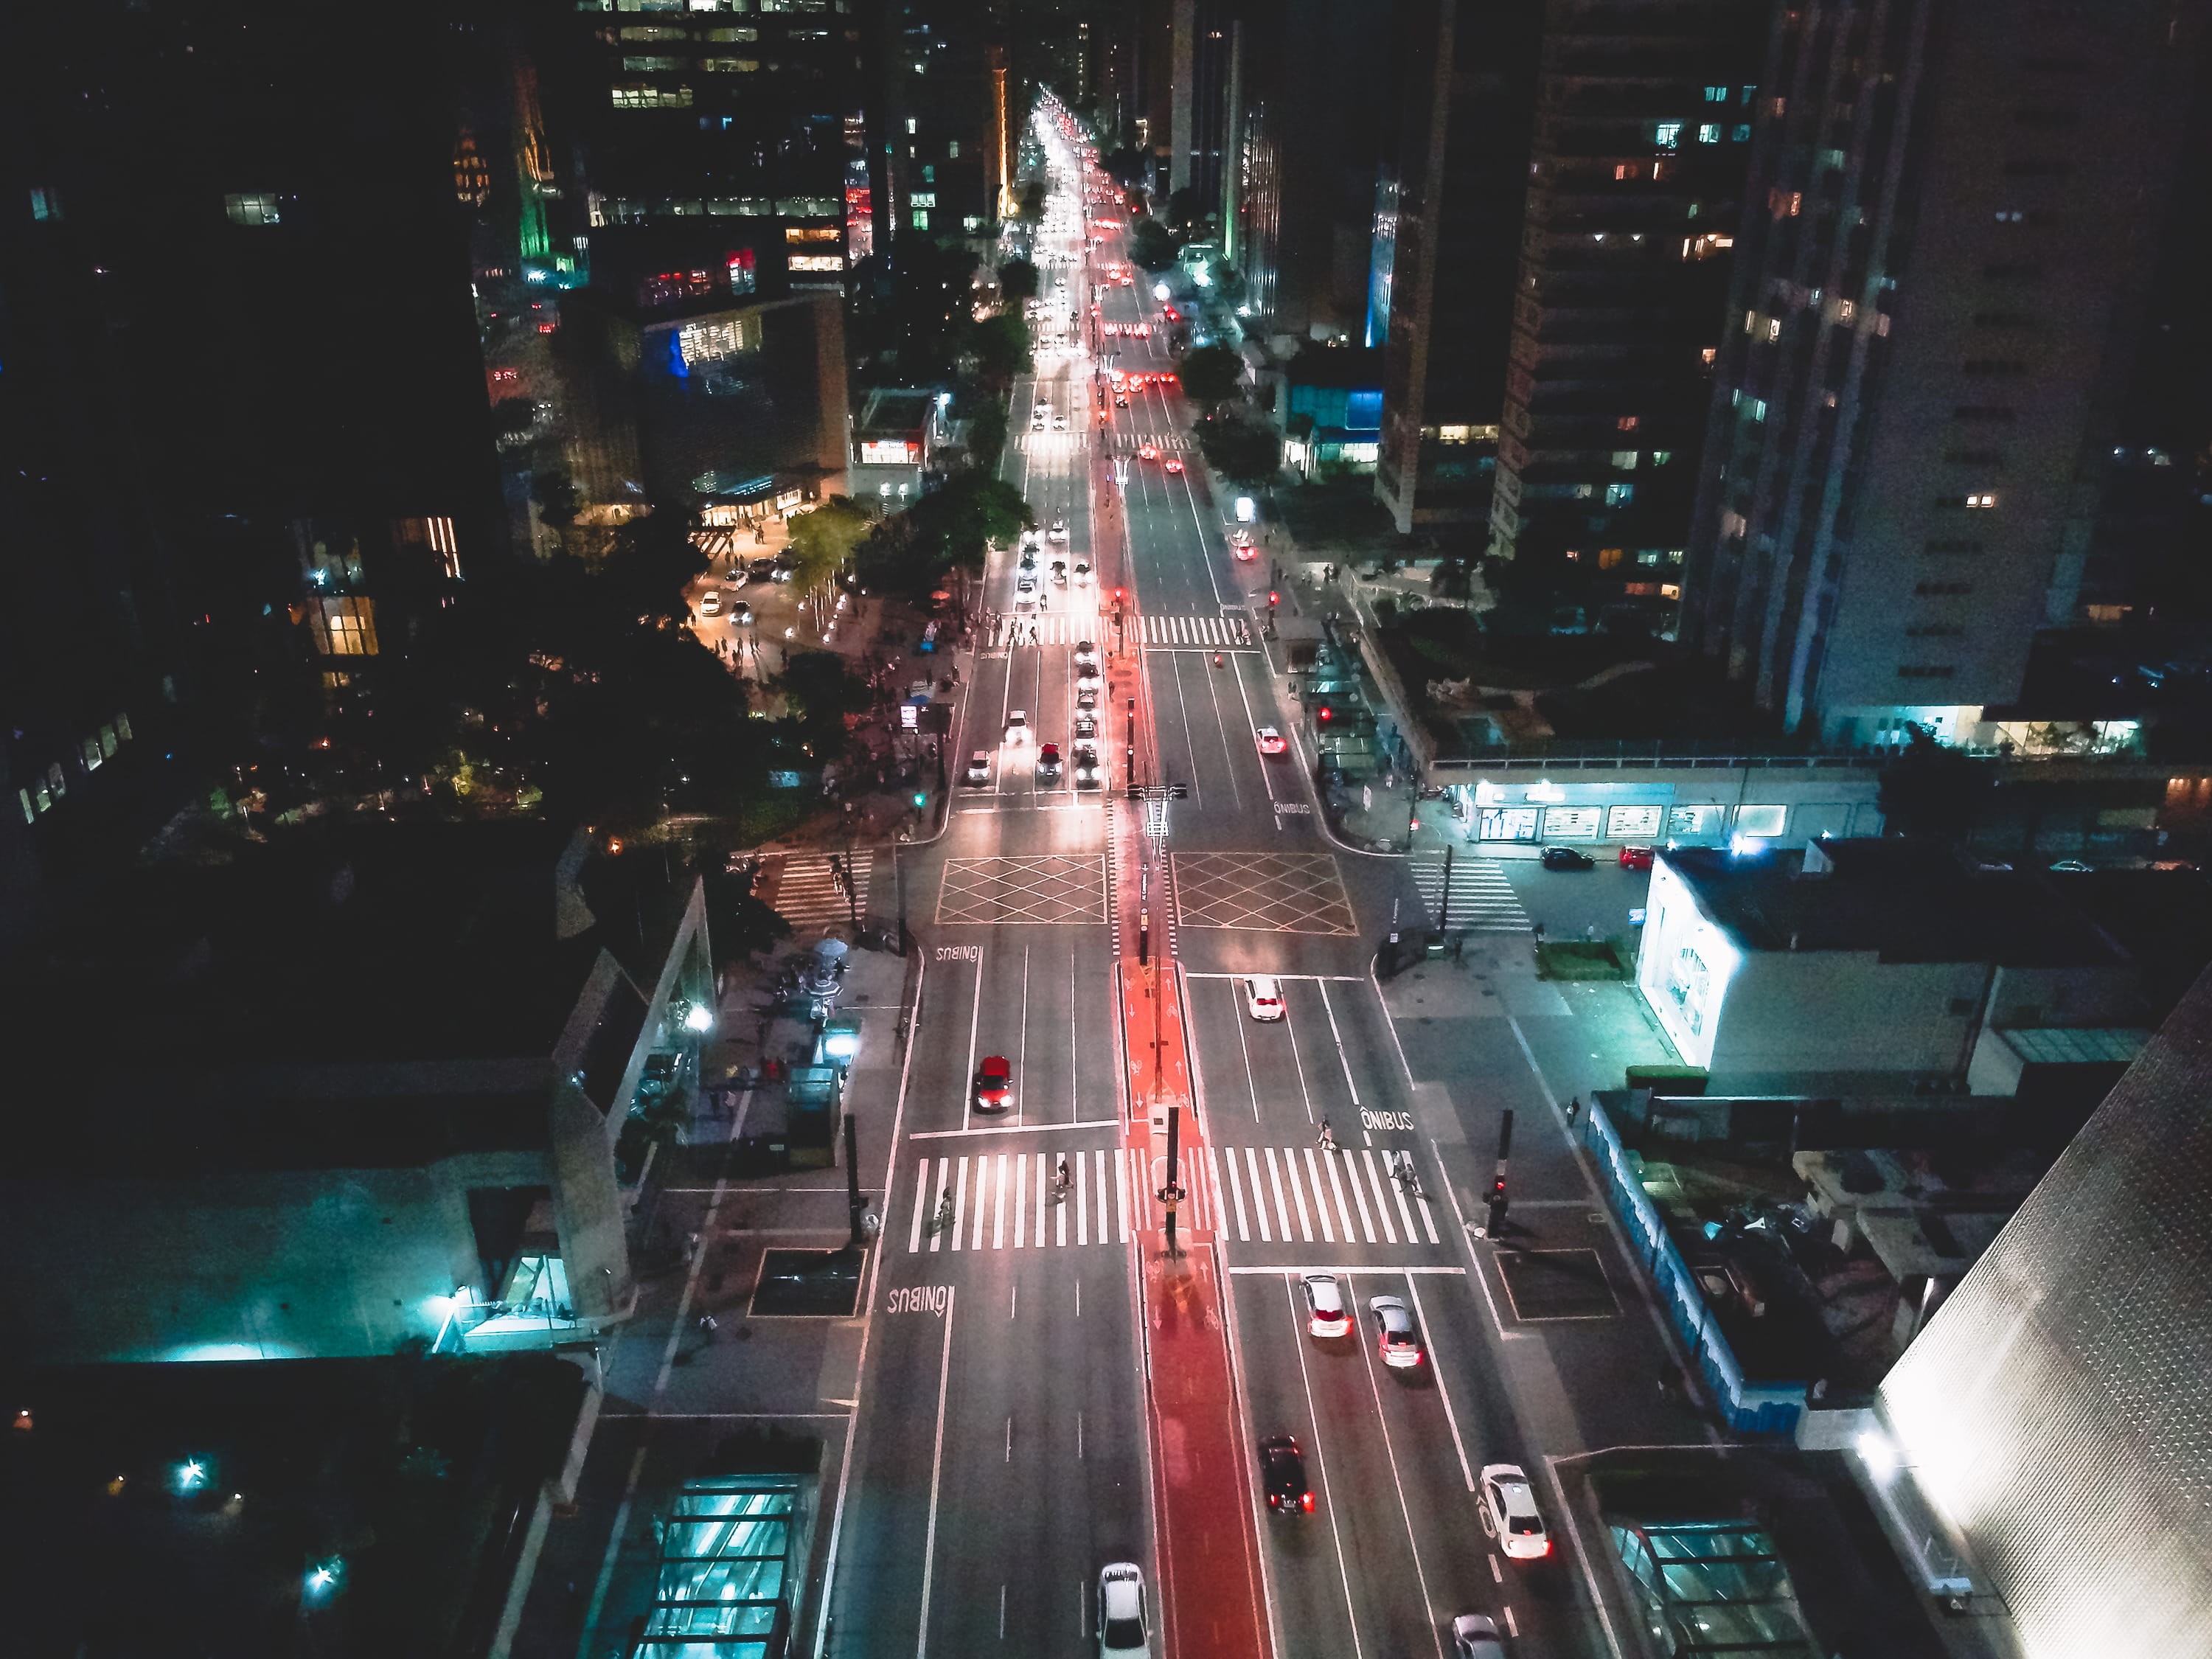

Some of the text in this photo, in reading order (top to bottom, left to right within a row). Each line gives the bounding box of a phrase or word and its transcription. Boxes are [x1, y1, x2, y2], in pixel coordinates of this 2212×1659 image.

[936, 946, 978, 962] ÔNIBUS
[1360, 1106, 1414, 1130] ÔNIBUS
[887, 1286, 947, 1318] ÔNIBUS
